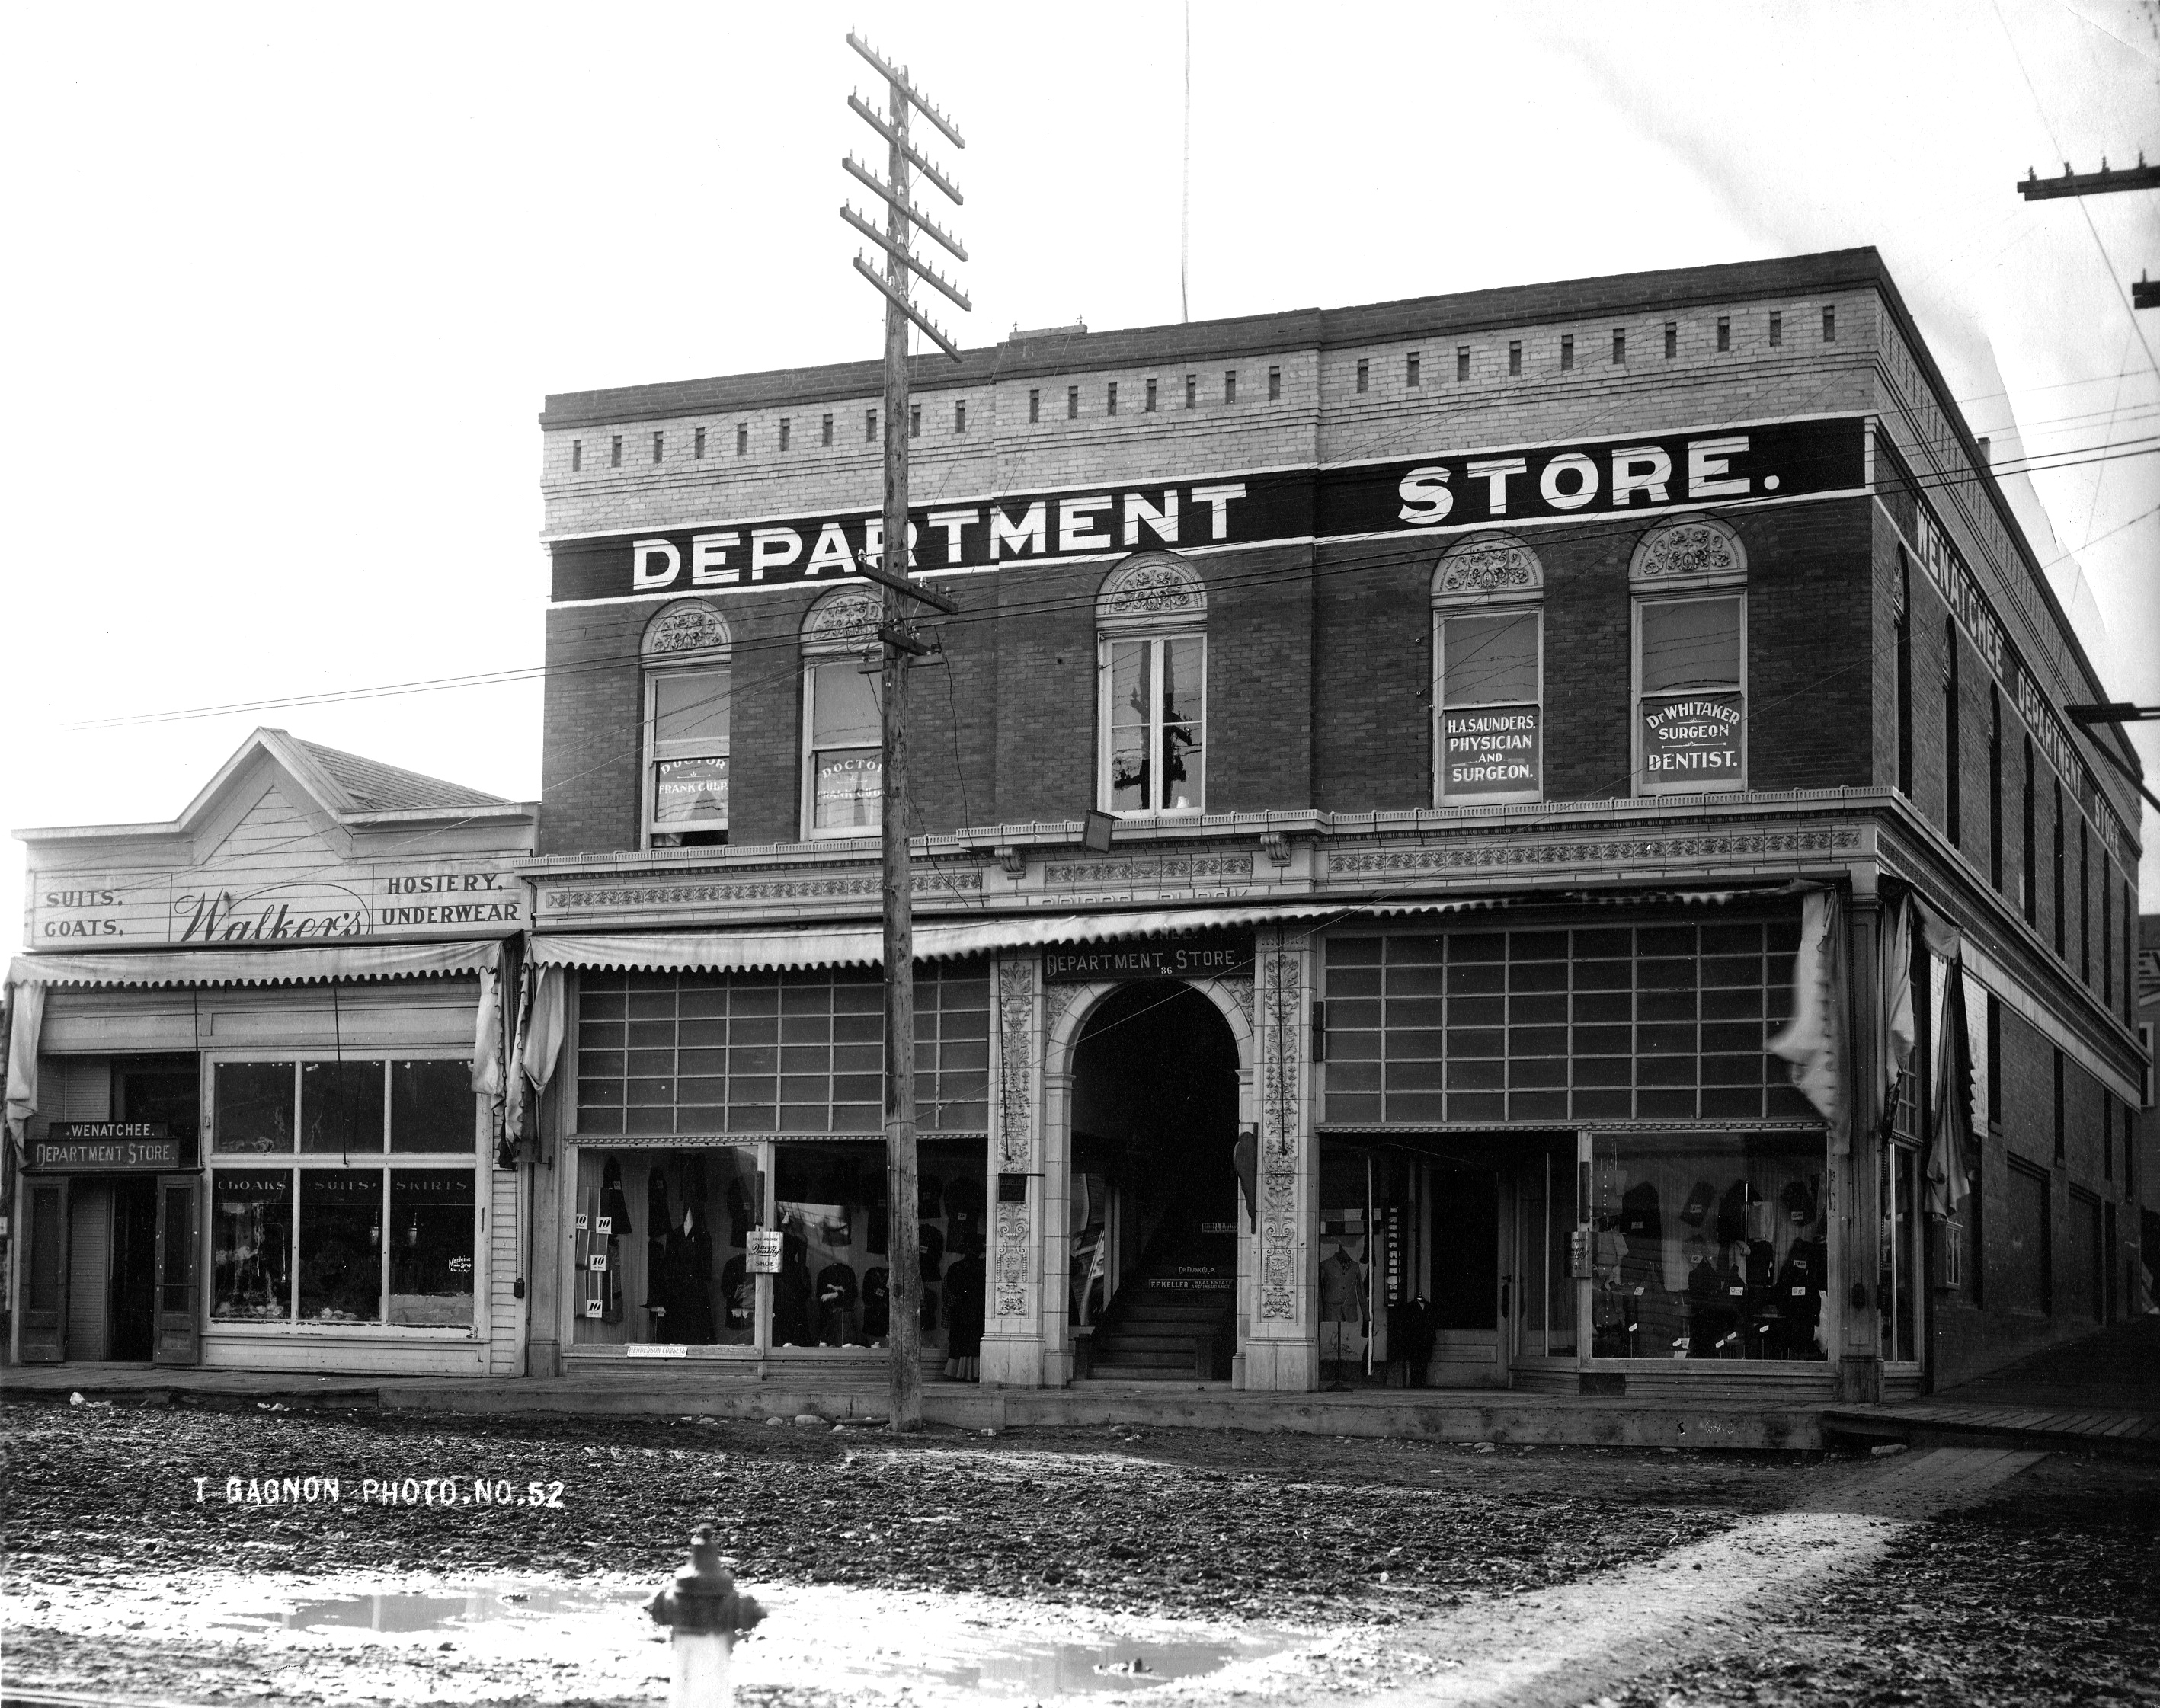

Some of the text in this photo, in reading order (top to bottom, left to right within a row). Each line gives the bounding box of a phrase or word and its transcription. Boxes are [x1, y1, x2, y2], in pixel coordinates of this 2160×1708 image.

[632, 435, 1780, 590] DEPARTMENT STORE.
[1917, 498, 2004, 680] WENATCHEE
[2018, 665, 2083, 800] DEPARTMENT
[1646, 702, 1740, 729] Dr WHITAKER
[1659, 724, 1729, 740] SURGEON
[1450, 734, 1532, 752] PHYSICIAN
[1478, 753, 1502, 763] AND
[1648, 750, 1738, 771] DENTIST.
[1453, 764, 1534, 782] SURGEON.
[659, 782, 696, 794] FRANK
[388, 874, 503, 894] HOSIERY,
[382, 904, 518, 925] UNDERWEAR
[1047, 949, 1243, 977] DEPARTMENT STORE.
[1160, 966, 1173, 974] 36
[37, 1143, 176, 1167] DEPARTMENT STORE.
[315, 1181, 368, 1190] SUITS
